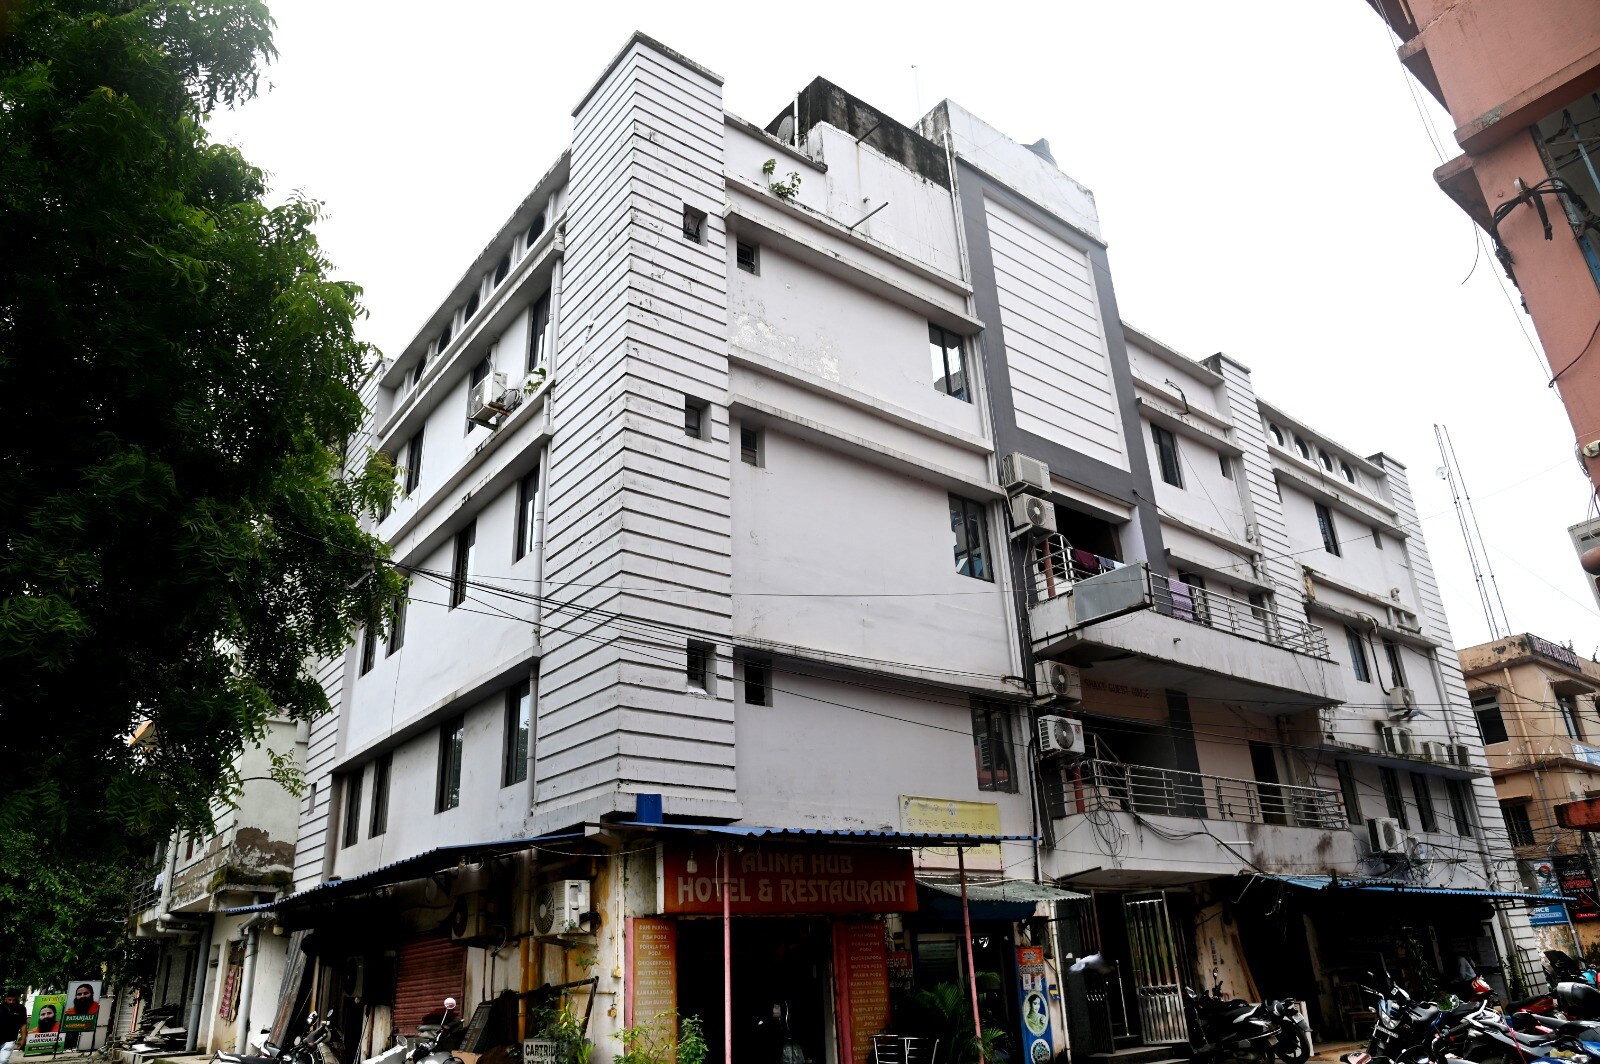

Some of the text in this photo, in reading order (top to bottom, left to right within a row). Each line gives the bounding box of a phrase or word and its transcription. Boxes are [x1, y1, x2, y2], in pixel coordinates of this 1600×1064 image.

[741, 852, 855, 875] ALINA HUB
[677, 876, 906, 905] HOTEL & RESTAURANT
[66, 1014, 94, 1022] PATANJALI
